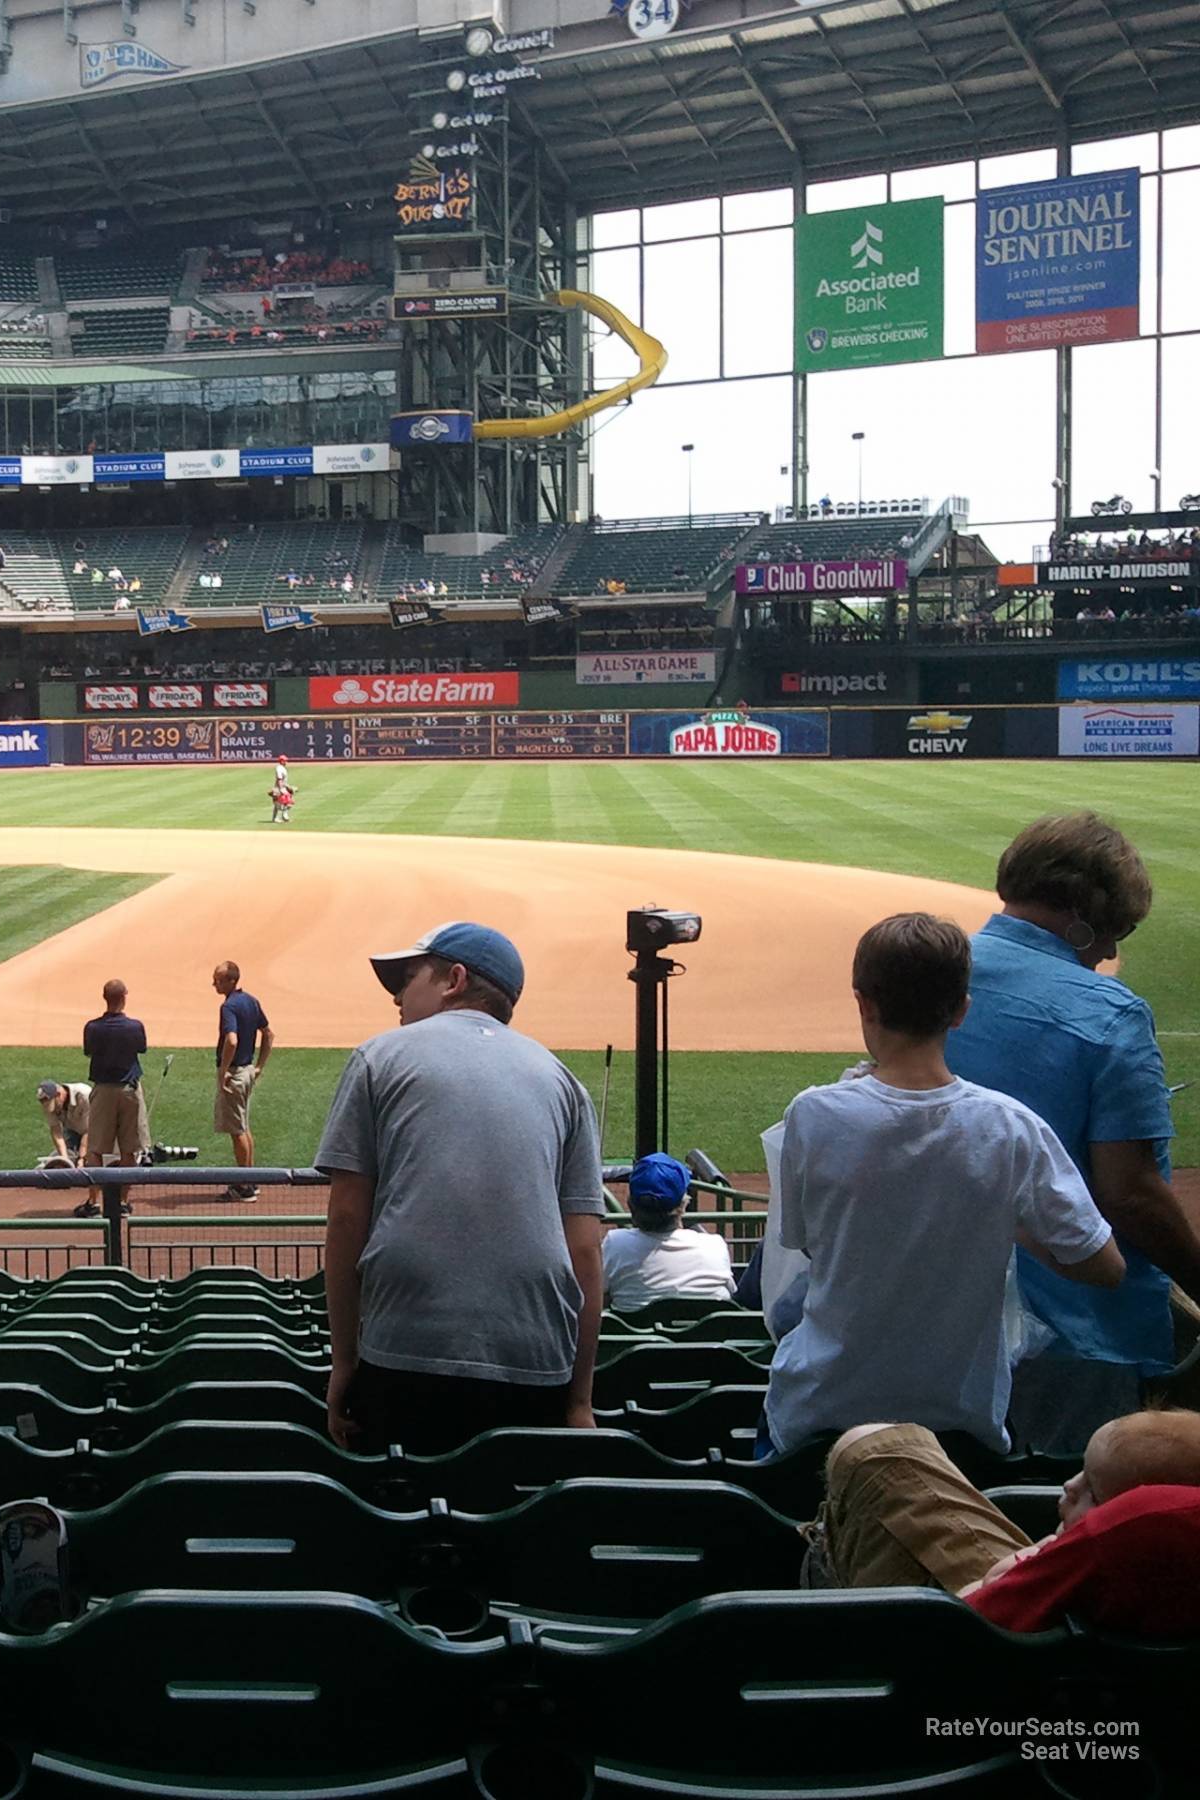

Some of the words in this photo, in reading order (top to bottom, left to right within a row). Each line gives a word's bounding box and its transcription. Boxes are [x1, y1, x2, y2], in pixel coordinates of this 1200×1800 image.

[635, 0, 673, 28] 34
[493, 30, 549, 53] Gone!
[468, 72, 493, 86] Get
[450, 115, 473, 127] Get
[474, 113, 493, 126] Up
[436, 145, 459, 157] Get
[984, 191, 1132, 239] JOURNAL
[984, 222, 1132, 266] SENTINEL
[1008, 260, 1106, 282] jsonline.com
[816, 267, 920, 297] Associated
[845, 292, 887, 313] Bank
[1006, 323, 1028, 335] ONE
[831, 333, 878, 348] BREWERS
[879, 328, 928, 344] CHECKING
[1006, 329, 1063, 344] UNLIMITED
[95, 463, 138, 472] STADIUM
[140, 462, 162, 470] CLUB
[242, 458, 285, 466] STADIUM
[288, 456, 311, 465] CLUB
[767, 566, 806, 591] Club
[812, 561, 894, 589] Goodwill
[1048, 562, 1190, 580] HARLEY-DAVIDSON
[658, 656, 698, 669] GAME
[1078, 663, 1200, 682] KOHL'S
[800, 671, 887, 696] impact
[1111, 684, 1140, 693] great
[358, 718, 382, 727] NYM
[411, 717, 438, 726] 2:45
[465, 716, 480, 725] SF
[497, 715, 519, 724] CLE
[548, 714, 574, 724] 5:35
[599, 713, 623, 723] BRE
[711, 712, 739, 721] PIZZA
[1086, 719, 1136, 727] AMERICAN
[1138, 719, 1173, 727] FAMILY
[241, 722, 256, 731] T3
[262, 721, 282, 731] OUT
[307, 721, 315, 730] R
[324, 721, 333, 729] H
[343, 720, 350, 729] E
[515, 727, 567, 736] HOLLANDS
[593, 727, 613, 736] 4-1
[118, 727, 181, 748] 12:39
[377, 729, 425, 738] WHEELER
[459, 728, 479, 737] 2-1
[674, 726, 718, 752] PAPA
[221, 736, 266, 747] BRAVES
[307, 735, 315, 745] 1
[325, 734, 333, 745] 2
[343, 734, 351, 744] 0
[415, 738, 435, 746] vs.
[908, 738, 968, 753] CHEVY
[221, 750, 273, 760] MARLINS
[307, 748, 315, 758] 4
[325, 748, 334, 758] 4
[343, 748, 351, 757] 0
[378, 747, 406, 755] CAIN
[460, 745, 480, 755] 5-5
[515, 744, 574, 753] MAGNIFICO
[593, 744, 614, 753] 0-1
[1084, 742, 1109, 753] LONG
[1111, 742, 1131, 752] LIVE
[1134, 742, 1174, 752] DREAMS
[177, 752, 216, 760] BASEBALL
